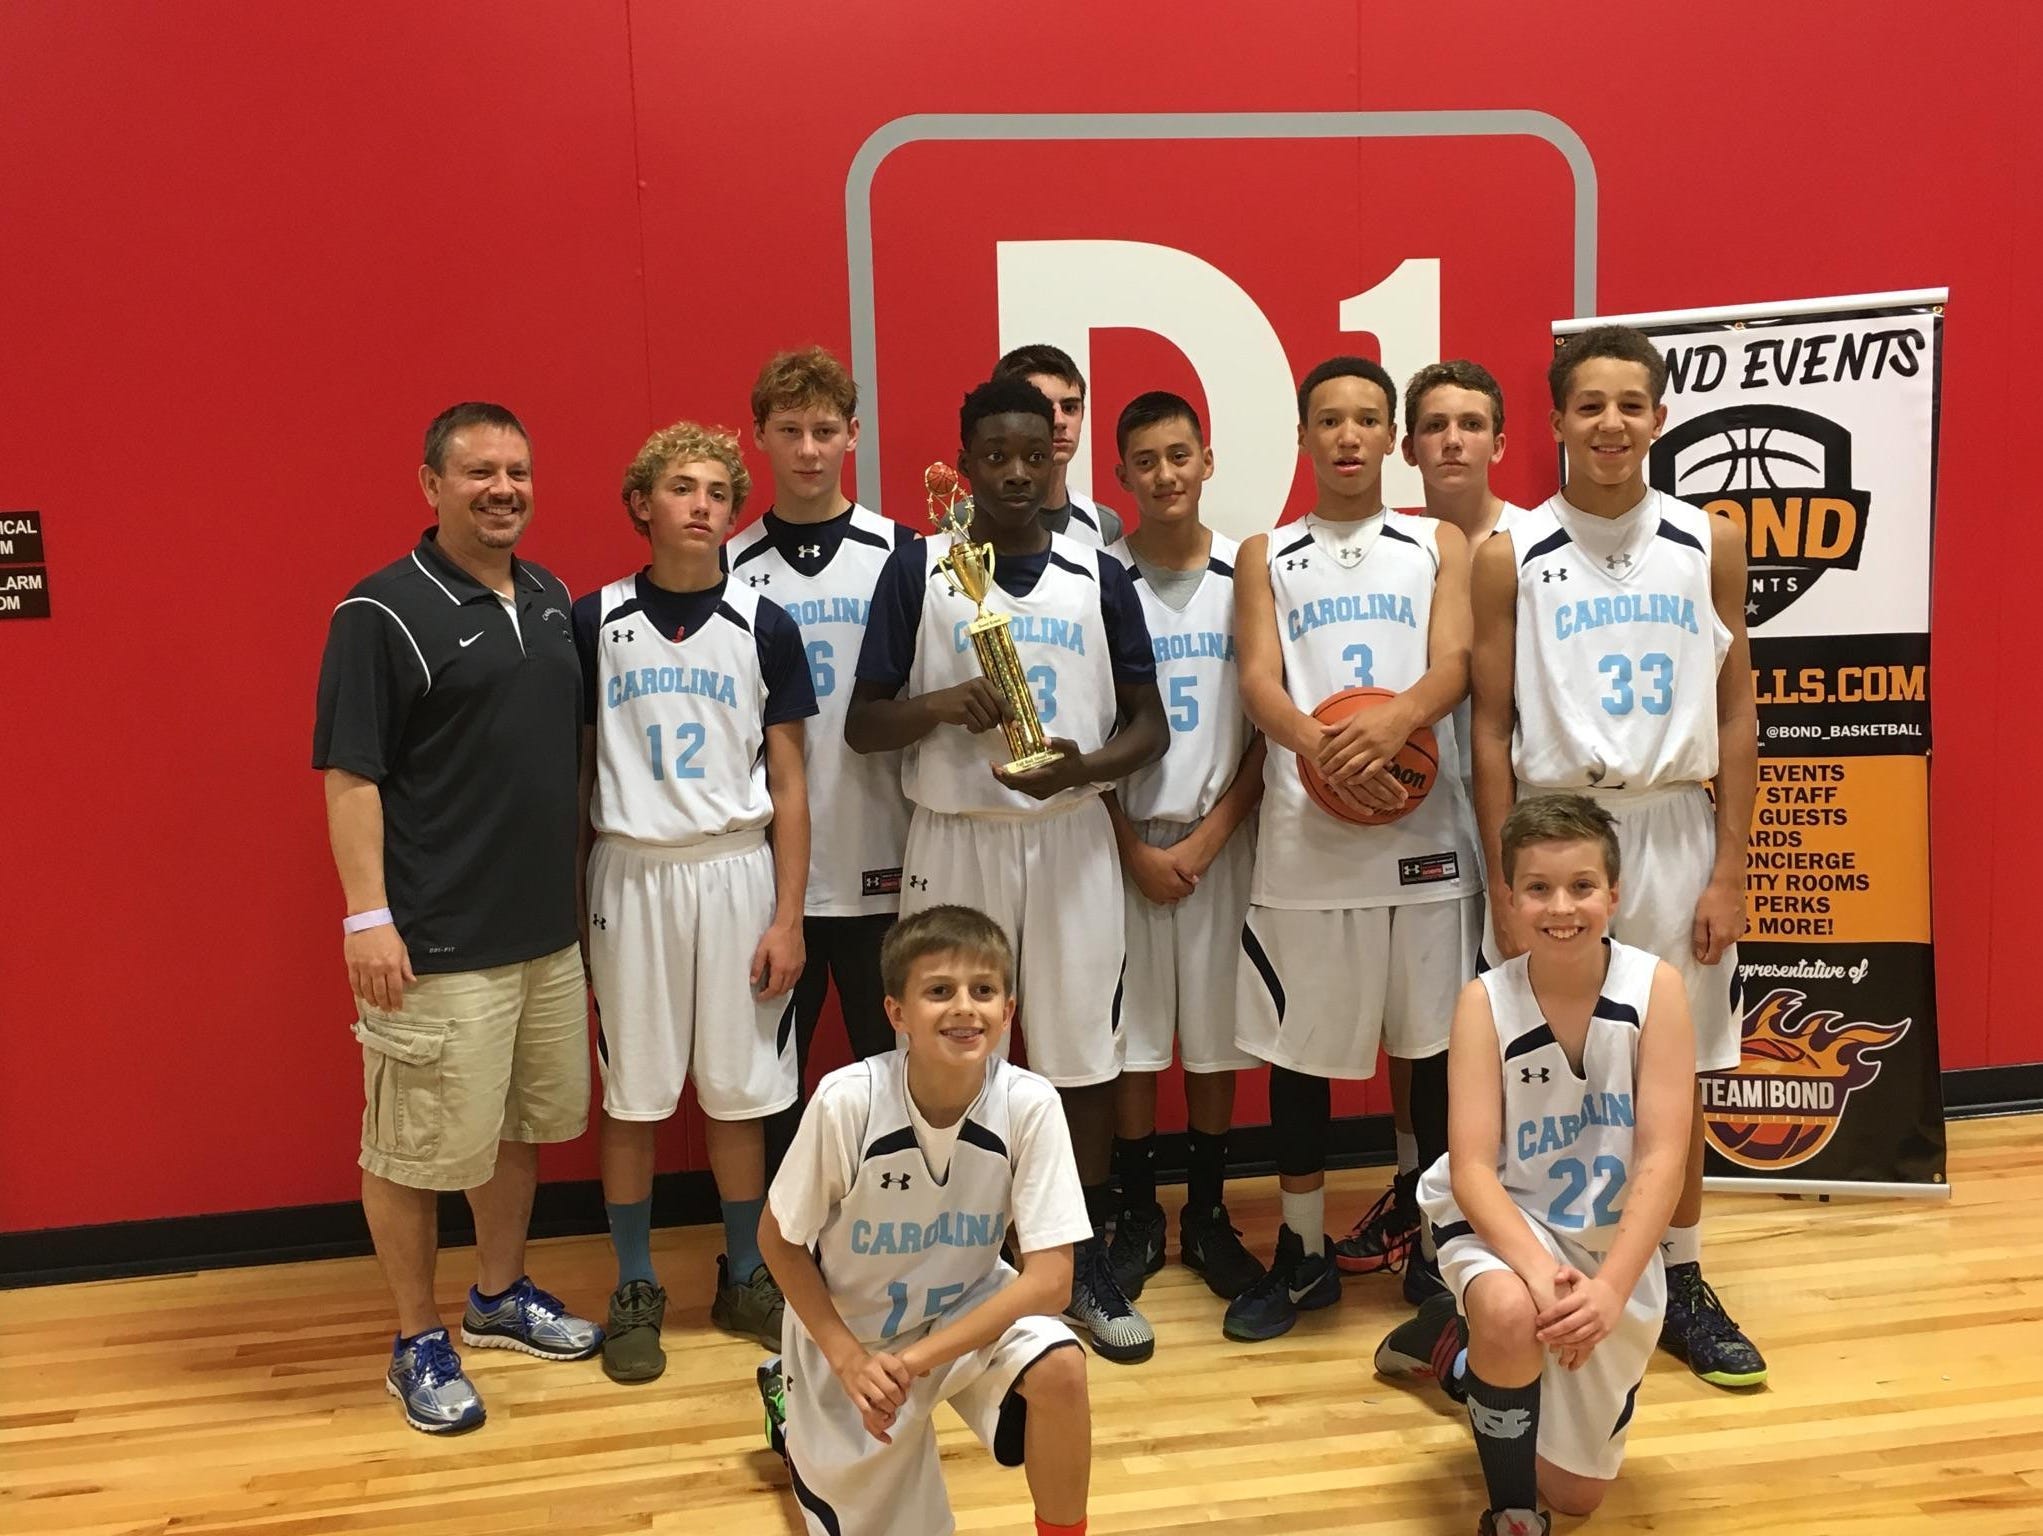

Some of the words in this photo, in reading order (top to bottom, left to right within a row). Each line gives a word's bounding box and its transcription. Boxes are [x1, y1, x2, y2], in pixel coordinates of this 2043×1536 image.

[1740, 328, 1926, 389] EVENTS
[953, 615, 1086, 657] COLINA
[1287, 593, 1418, 642] CAROLINA
[1555, 593, 1700, 642] CAROLINA
[1342, 643, 1375, 690] 3
[1598, 652, 1675, 716] 33
[607, 667, 737, 711] CAROLINA
[1766, 723, 1923, 740] @BOND_BASKETBALL
[646, 722, 706, 781] 12
[1759, 764, 1845, 782] EVENTS
[1766, 787, 1838, 804] STAFF
[1759, 808, 1848, 826] GUESTS
[1786, 874, 1870, 891] ROOMS
[1755, 895, 1831, 914] PERKS
[1759, 917, 1834, 935] MORE!
[1848, 958, 1869, 985] of
[1698, 1078, 1763, 1108] TEAM
[1769, 1080, 1835, 1110] BOND
[1547, 1154, 1627, 1229] 22
